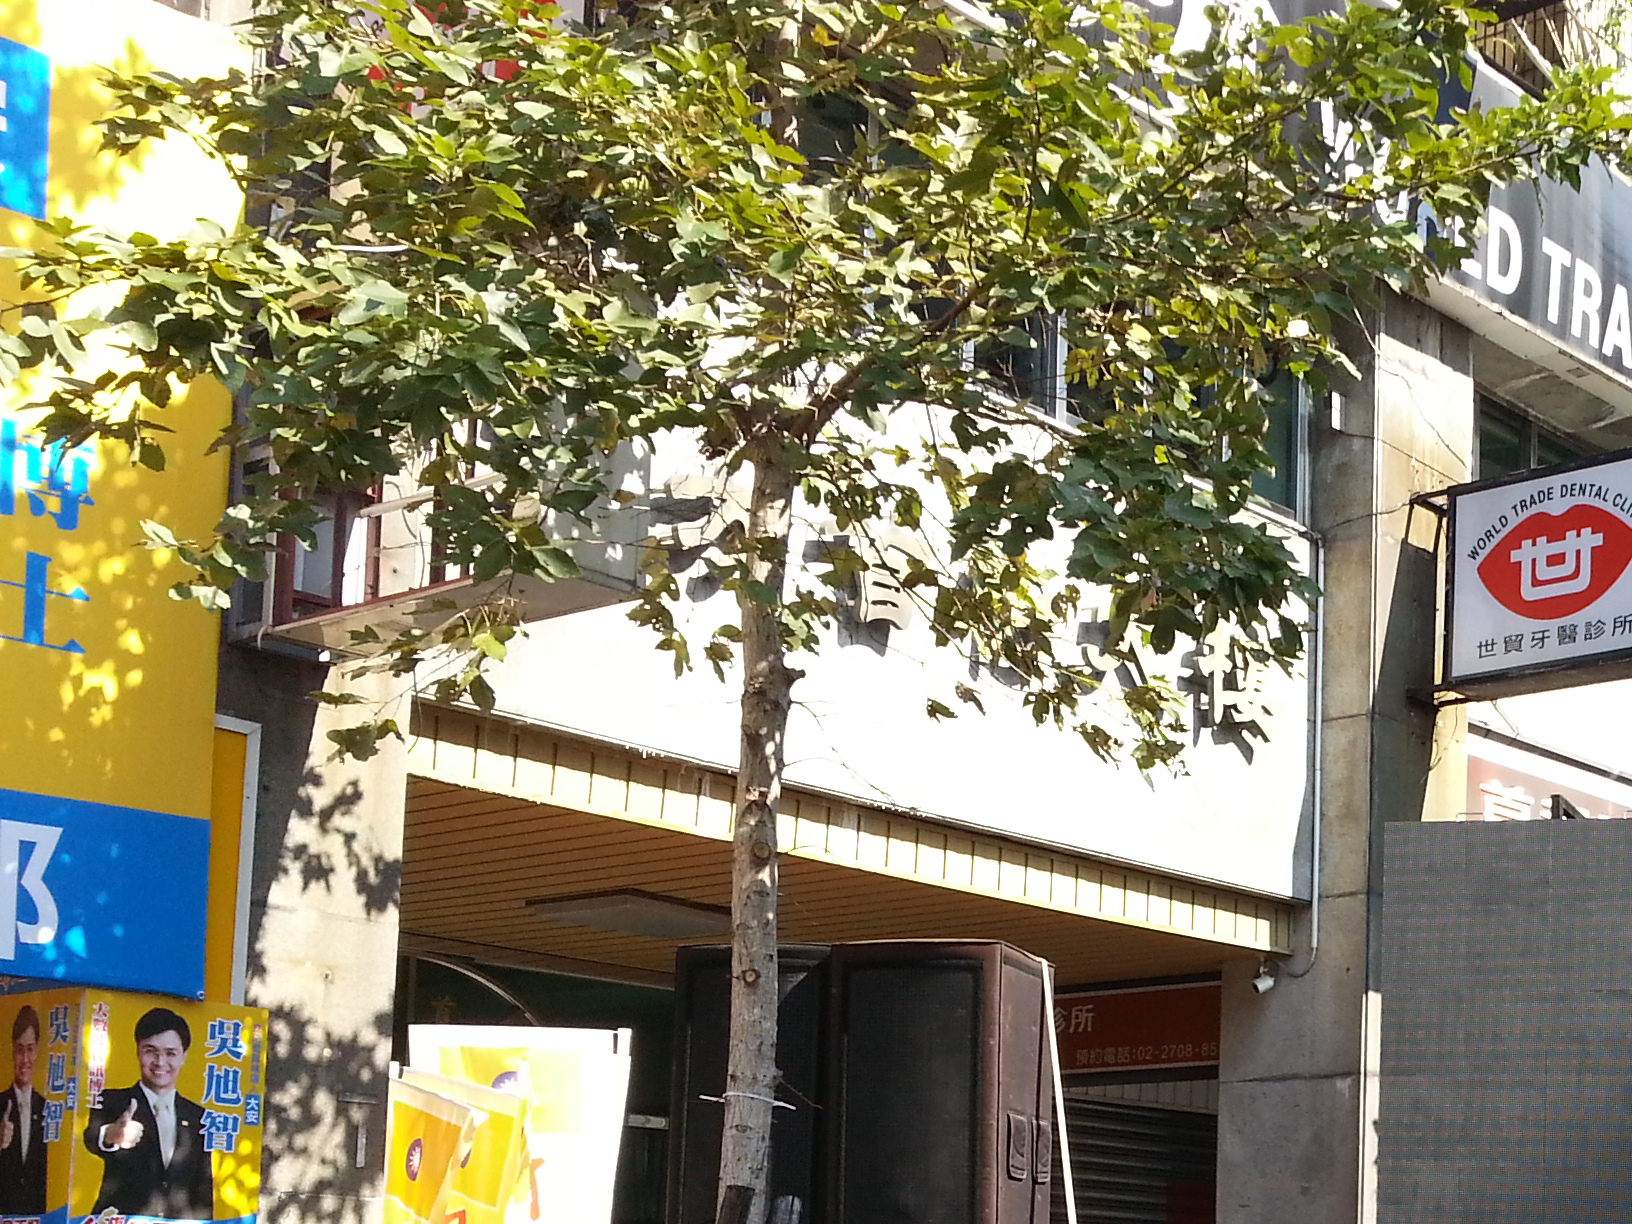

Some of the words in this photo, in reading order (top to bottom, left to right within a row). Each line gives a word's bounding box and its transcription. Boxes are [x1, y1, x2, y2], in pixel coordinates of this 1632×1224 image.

[1467, 514, 1509, 562] WORLD
[1511, 486, 1554, 518] TRADE
[1560, 482, 1609, 503] DENTAL
[200, 1018, 246, 1153] 吳旭智
